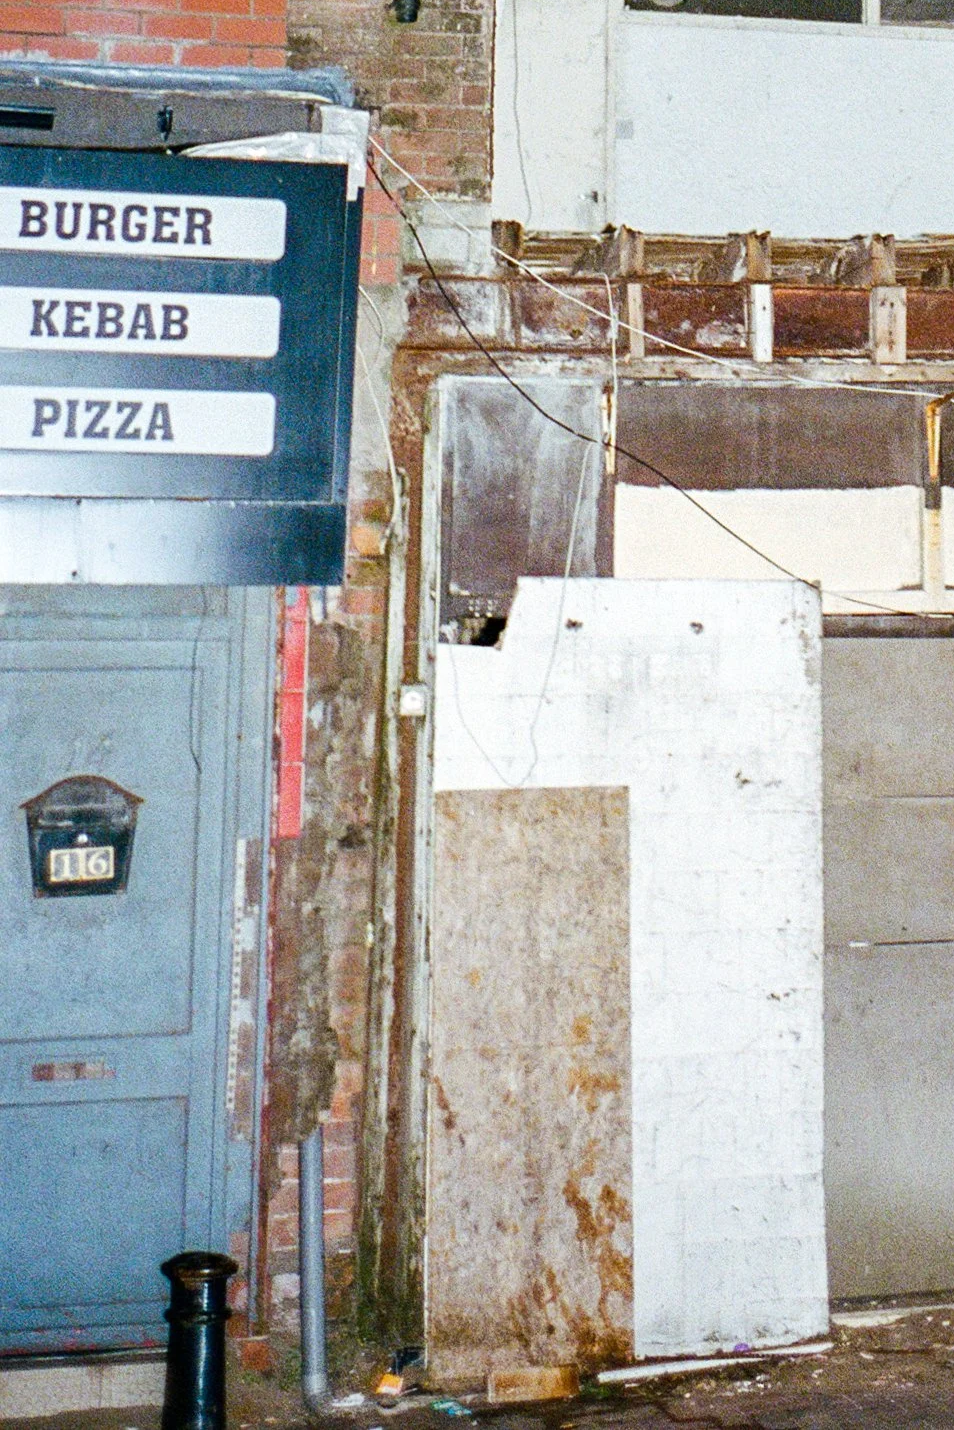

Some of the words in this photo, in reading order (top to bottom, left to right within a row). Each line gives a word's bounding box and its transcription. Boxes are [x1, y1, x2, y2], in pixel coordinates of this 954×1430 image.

[18, 200, 212, 245] BURGER
[29, 299, 188, 340] KEBAB
[31, 398, 174, 440] PIZZA
[58, 851, 109, 878] 16
